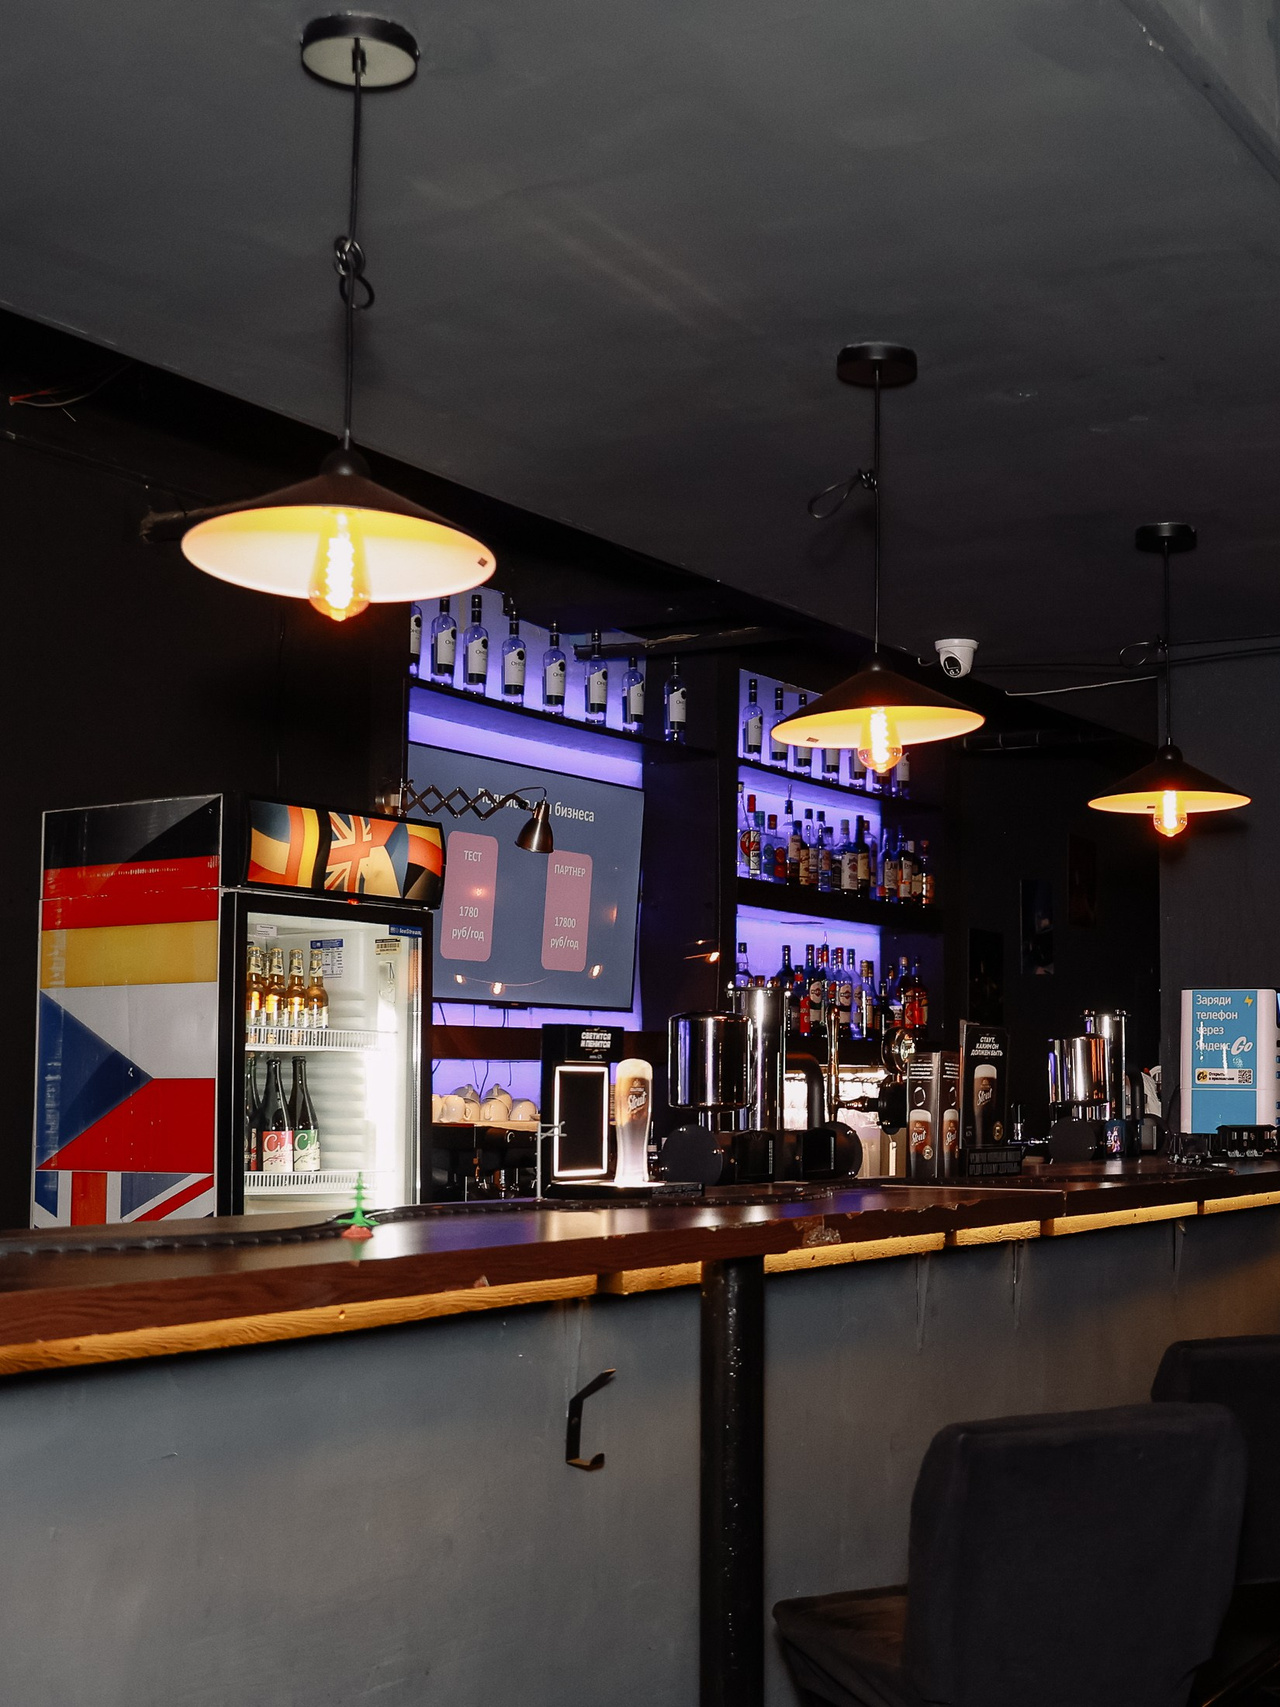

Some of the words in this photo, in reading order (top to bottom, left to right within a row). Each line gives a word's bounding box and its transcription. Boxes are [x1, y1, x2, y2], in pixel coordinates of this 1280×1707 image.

[555, 802, 595, 822] бизнеса
[464, 850, 482, 862] ТЕСТ
[554, 864, 586, 877] ПАРТНЕР
[459, 906, 479, 918] 1780
[554, 916, 576, 928] 17800
[452, 927, 484, 942] руб/год
[550, 936, 579, 950] руб/год
[1196, 994, 1231, 1006] Заряди
[1196, 1009, 1238, 1021] телефон
[1196, 1026, 1224, 1036] через
[1195, 1041, 1231, 1052] Яндекс
[1230, 1036, 1253, 1055] Go
